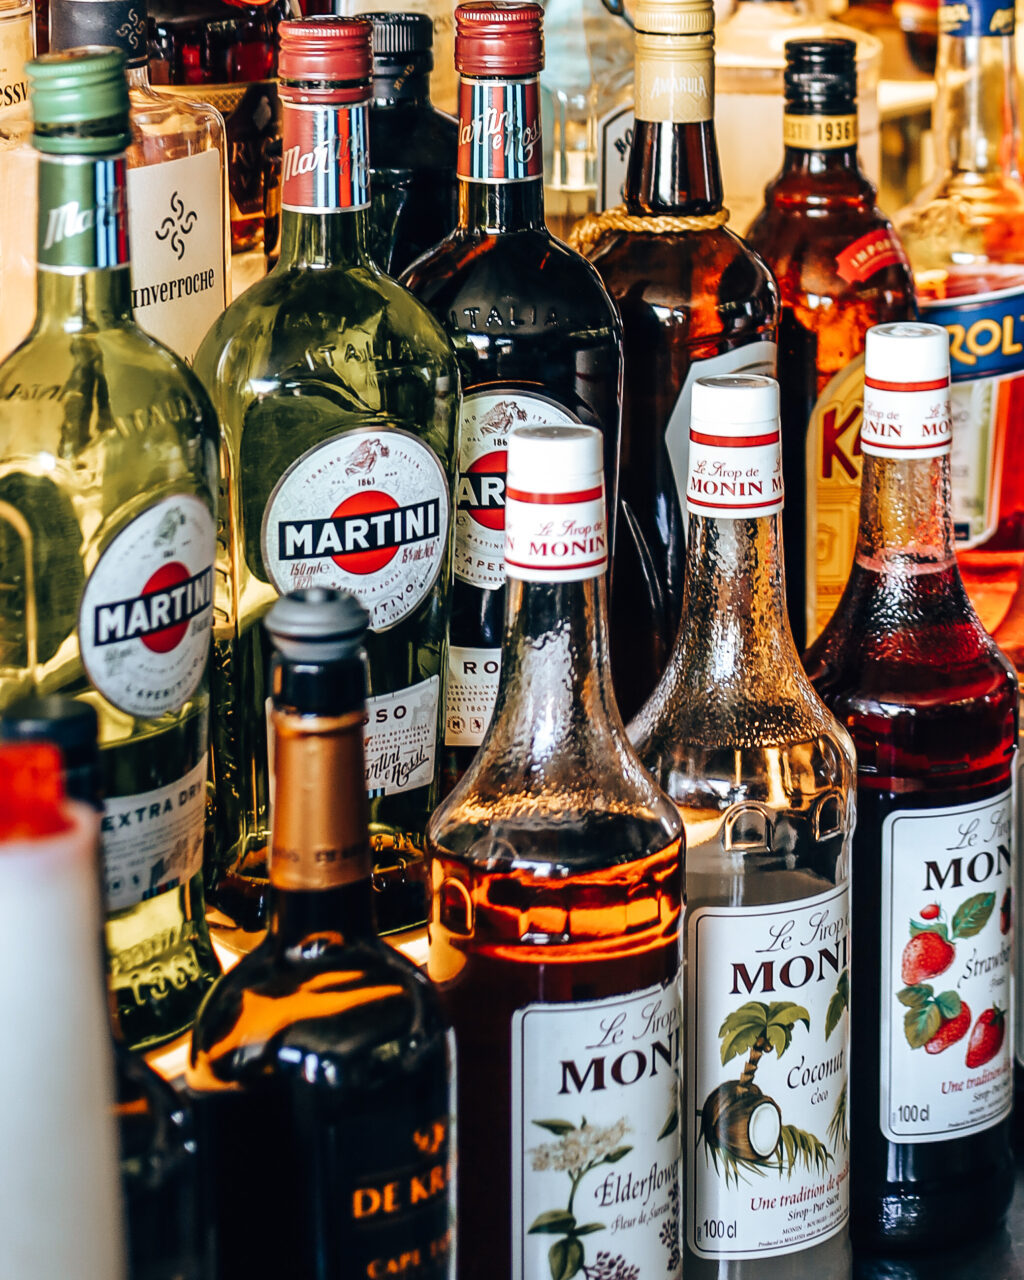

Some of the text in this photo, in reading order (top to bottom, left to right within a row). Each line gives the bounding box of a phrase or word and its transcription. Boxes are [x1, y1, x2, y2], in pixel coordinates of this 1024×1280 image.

[650, 75, 708, 100] AMARULA
[817, 121, 850, 141] 1936
[690, 477, 763, 496] MONIN
[693, 460, 760, 481] Le Sirop de
[285, 503, 436, 558] MARTINI
[98, 571, 212, 643] MARTINI
[101, 798, 173, 833] EXTRA
[946, 818, 980, 851] Le
[755, 909, 844, 954] Le Sirop
[729, 936, 847, 995] MONI
[585, 1012, 628, 1051] Le
[786, 1049, 844, 1090] Coconut
[811, 1086, 829, 1106] Coco
[941, 1080, 964, 1095] Une
[353, 1182, 400, 1219] DE
[750, 1174, 836, 1212] Une tradition de
[637, 1212, 647, 1225] de
[703, 1219, 725, 1239] 100
